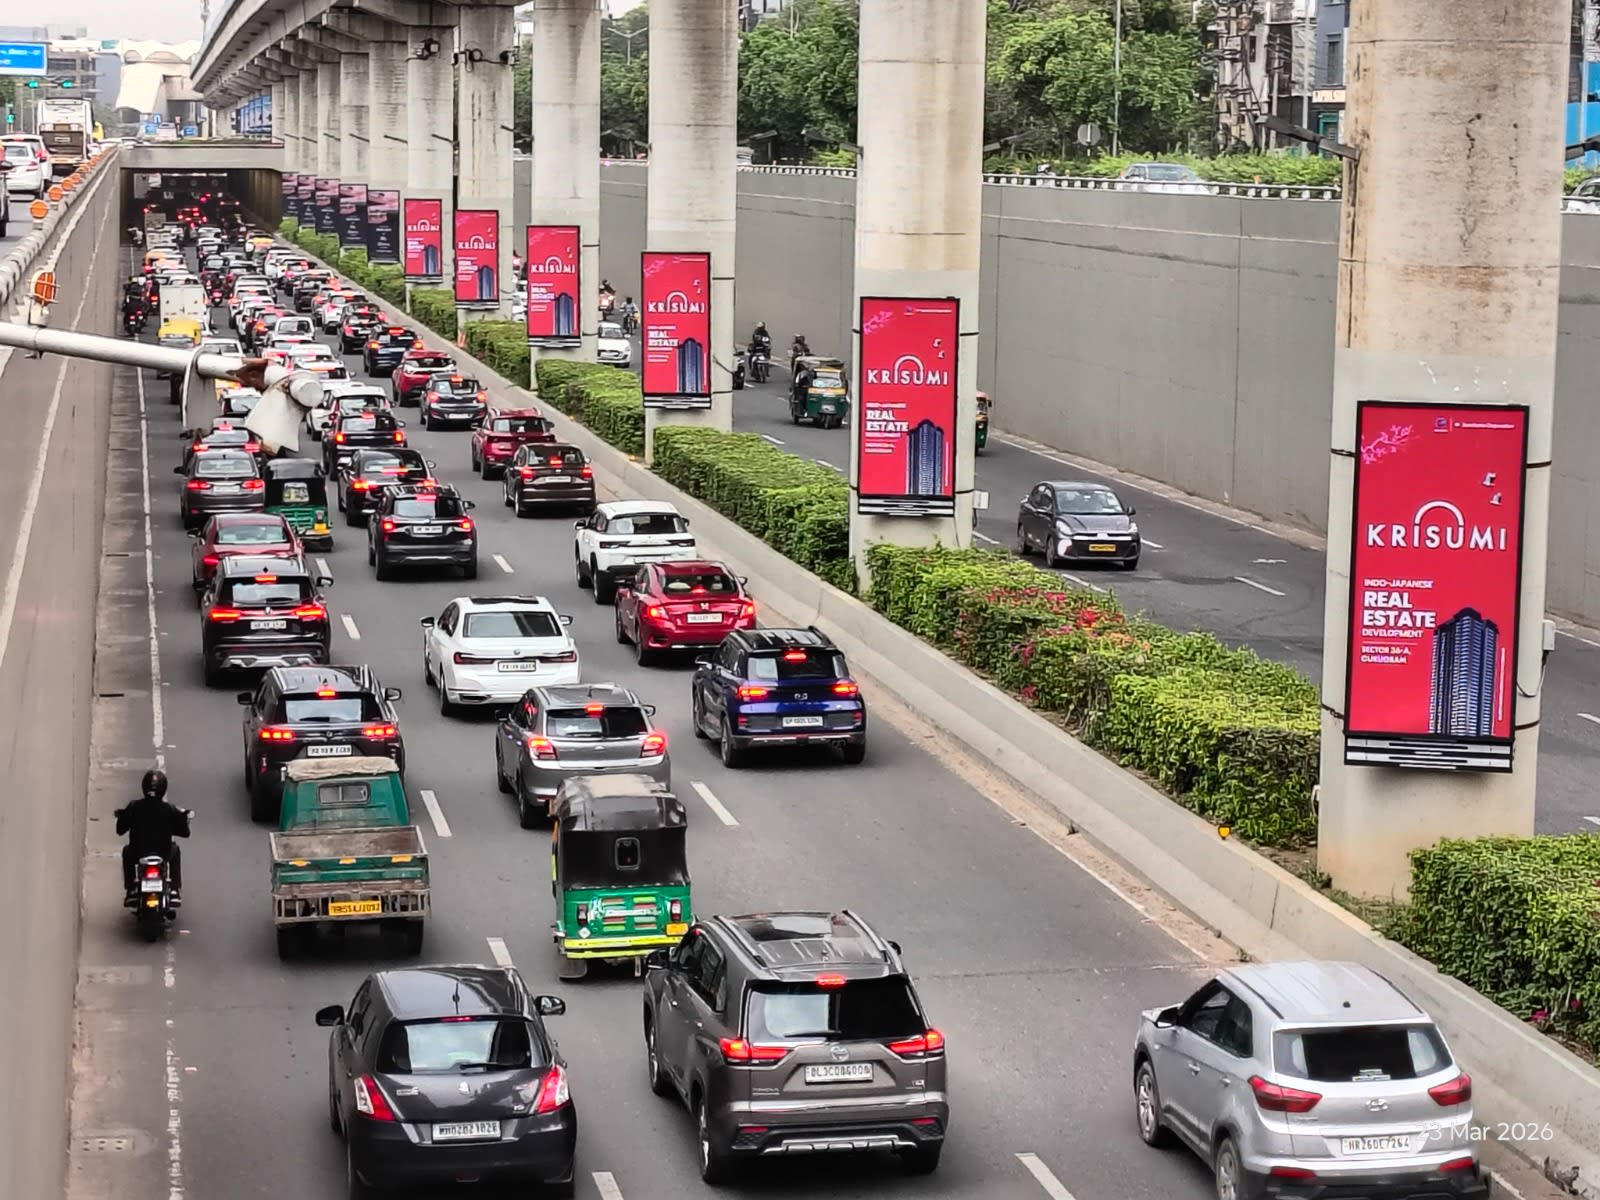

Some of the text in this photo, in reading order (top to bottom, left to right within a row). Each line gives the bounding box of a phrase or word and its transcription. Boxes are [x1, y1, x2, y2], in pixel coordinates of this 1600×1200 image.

[647, 301, 705, 313] KRISUMI
[867, 369, 948, 385] KRISUMI
[866, 410, 896, 420] REAL
[866, 421, 909, 432] ESTATE
[1367, 523, 1507, 551] KRISUMI
[1363, 591, 1413, 608] REAL
[1363, 609, 1436, 628] ESTATE
[1362, 628, 1424, 638] DEVELOPMENT
